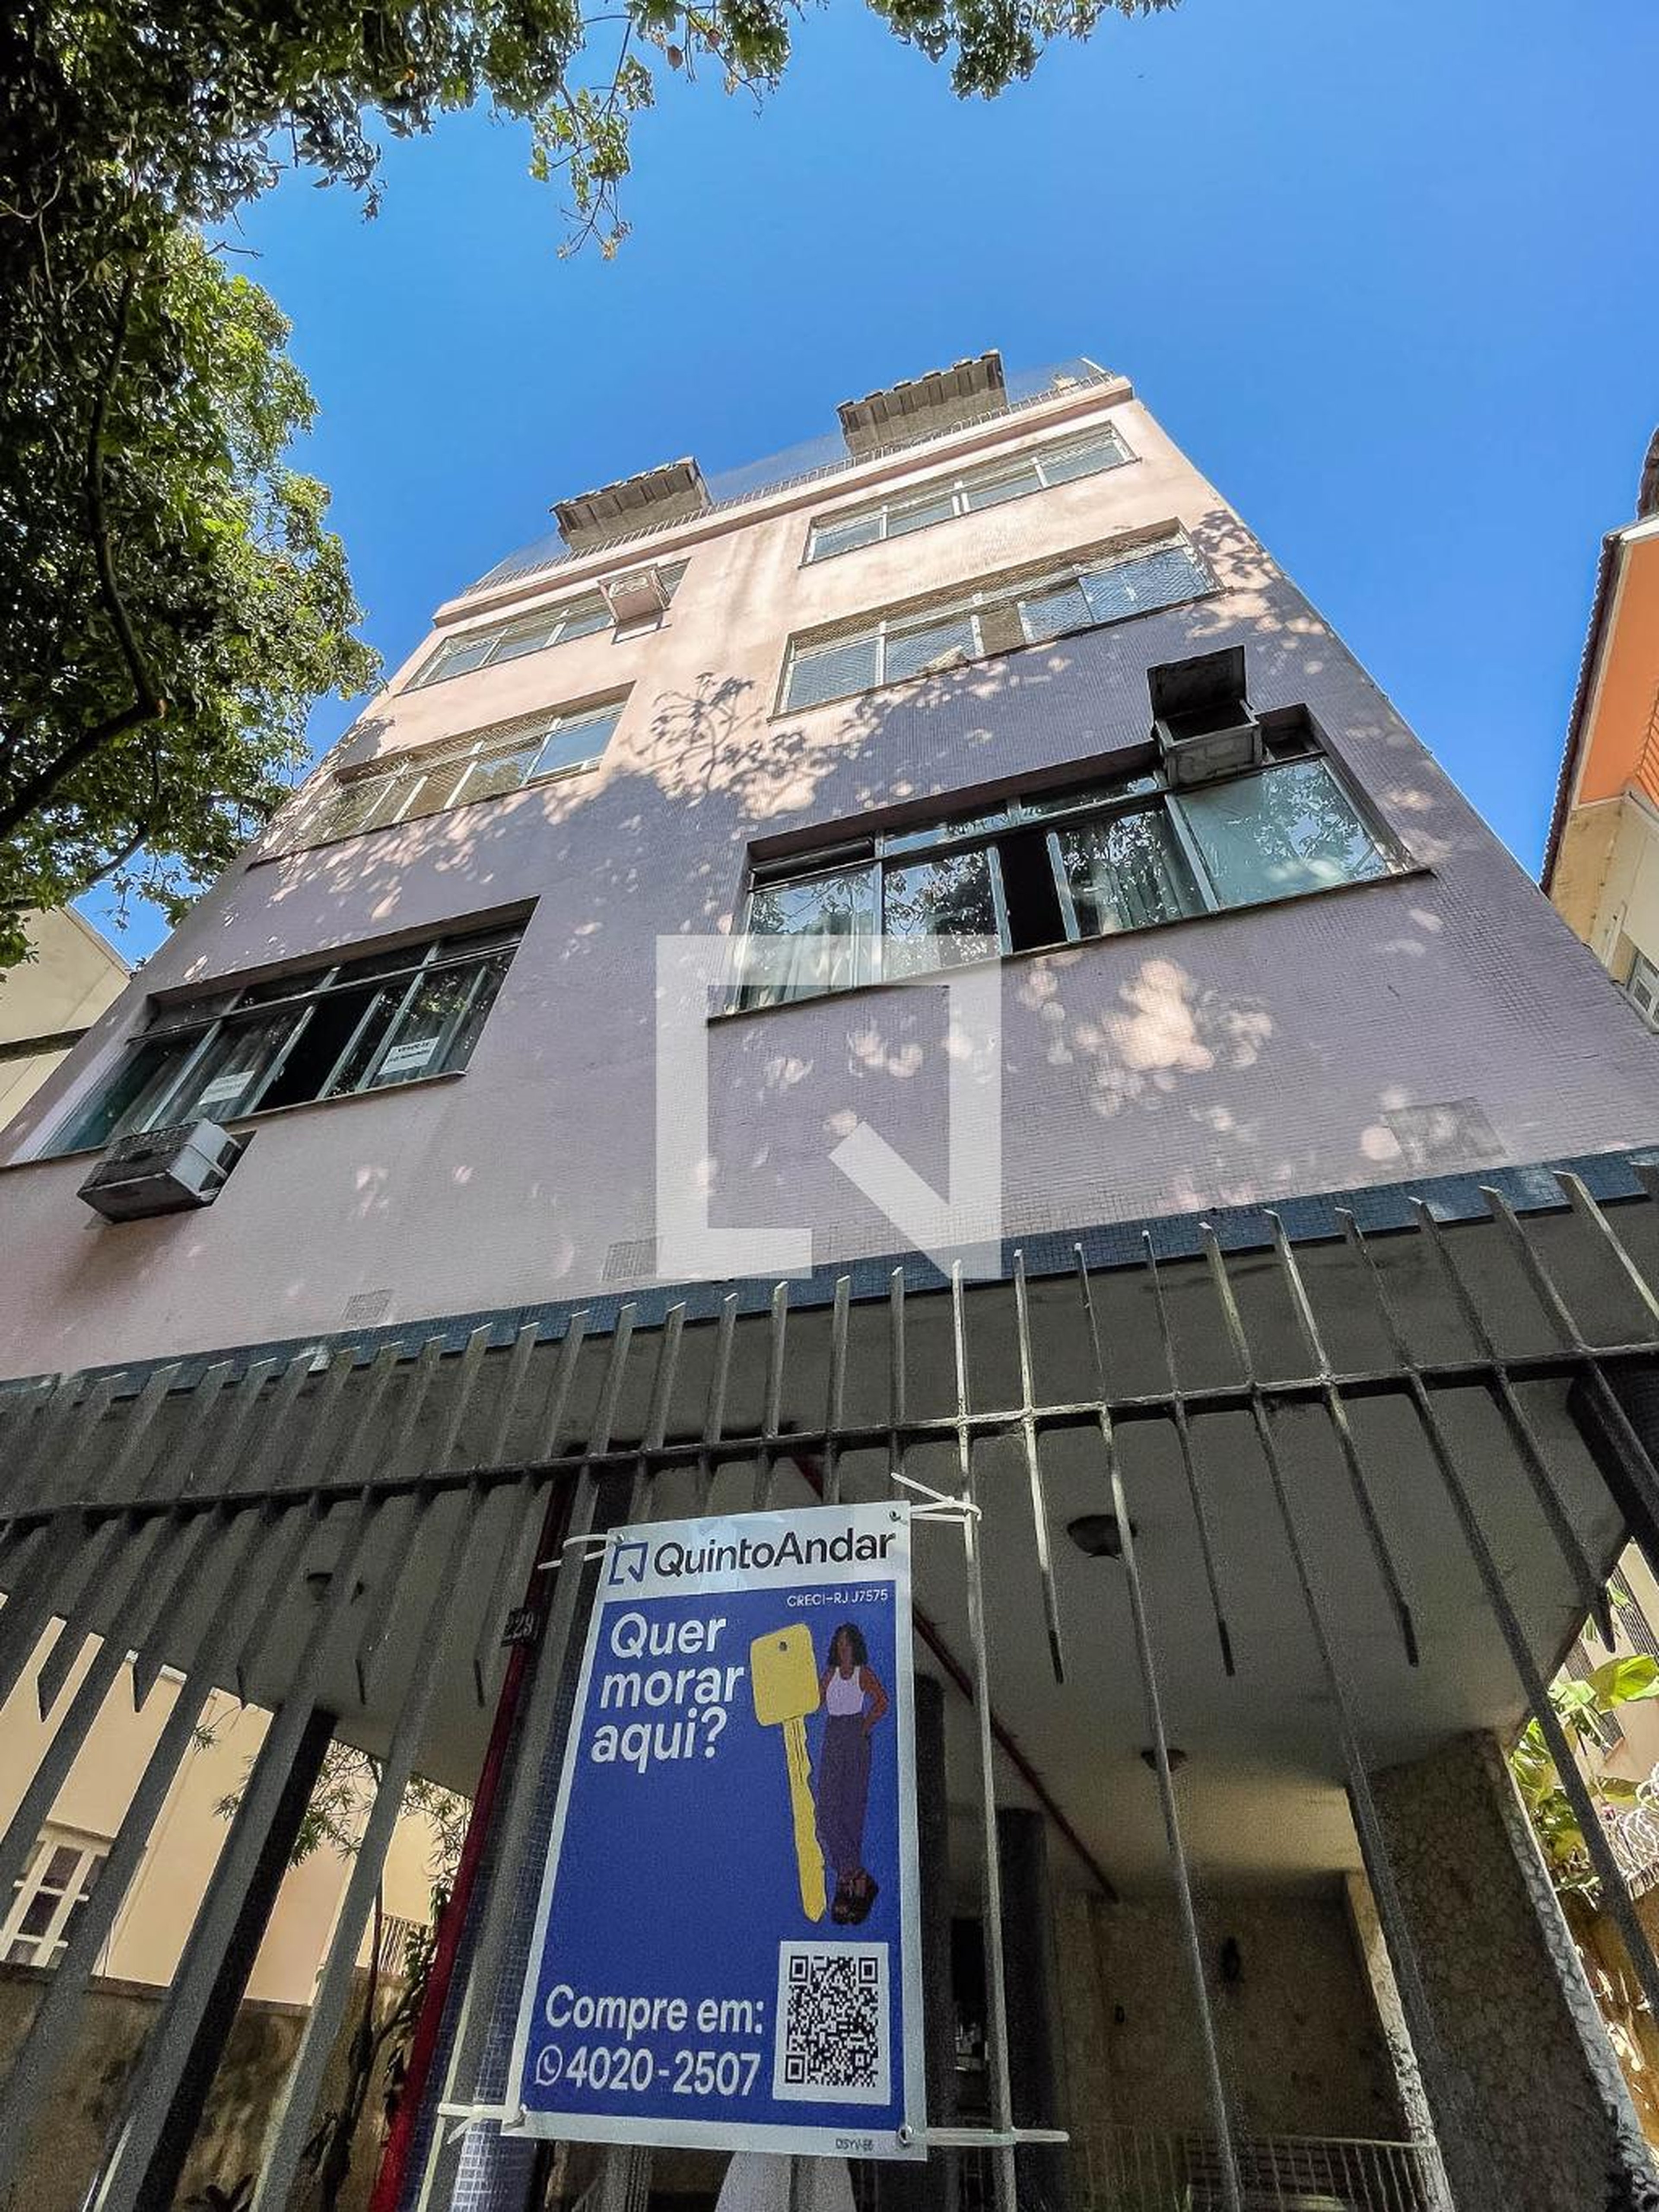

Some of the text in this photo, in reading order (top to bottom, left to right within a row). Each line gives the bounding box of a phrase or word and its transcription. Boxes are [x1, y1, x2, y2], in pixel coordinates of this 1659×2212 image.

[654, 1528, 896, 1577] QuintoAndar
[787, 1588, 889, 1607] CRECI-RJ J7575
[611, 1612, 727, 1659] Quer
[600, 1667, 744, 1709] morar
[591, 1706, 727, 1773] aqui?
[545, 1984, 764, 2040] Compre em:
[566, 2046, 761, 2096] 4020-2507
